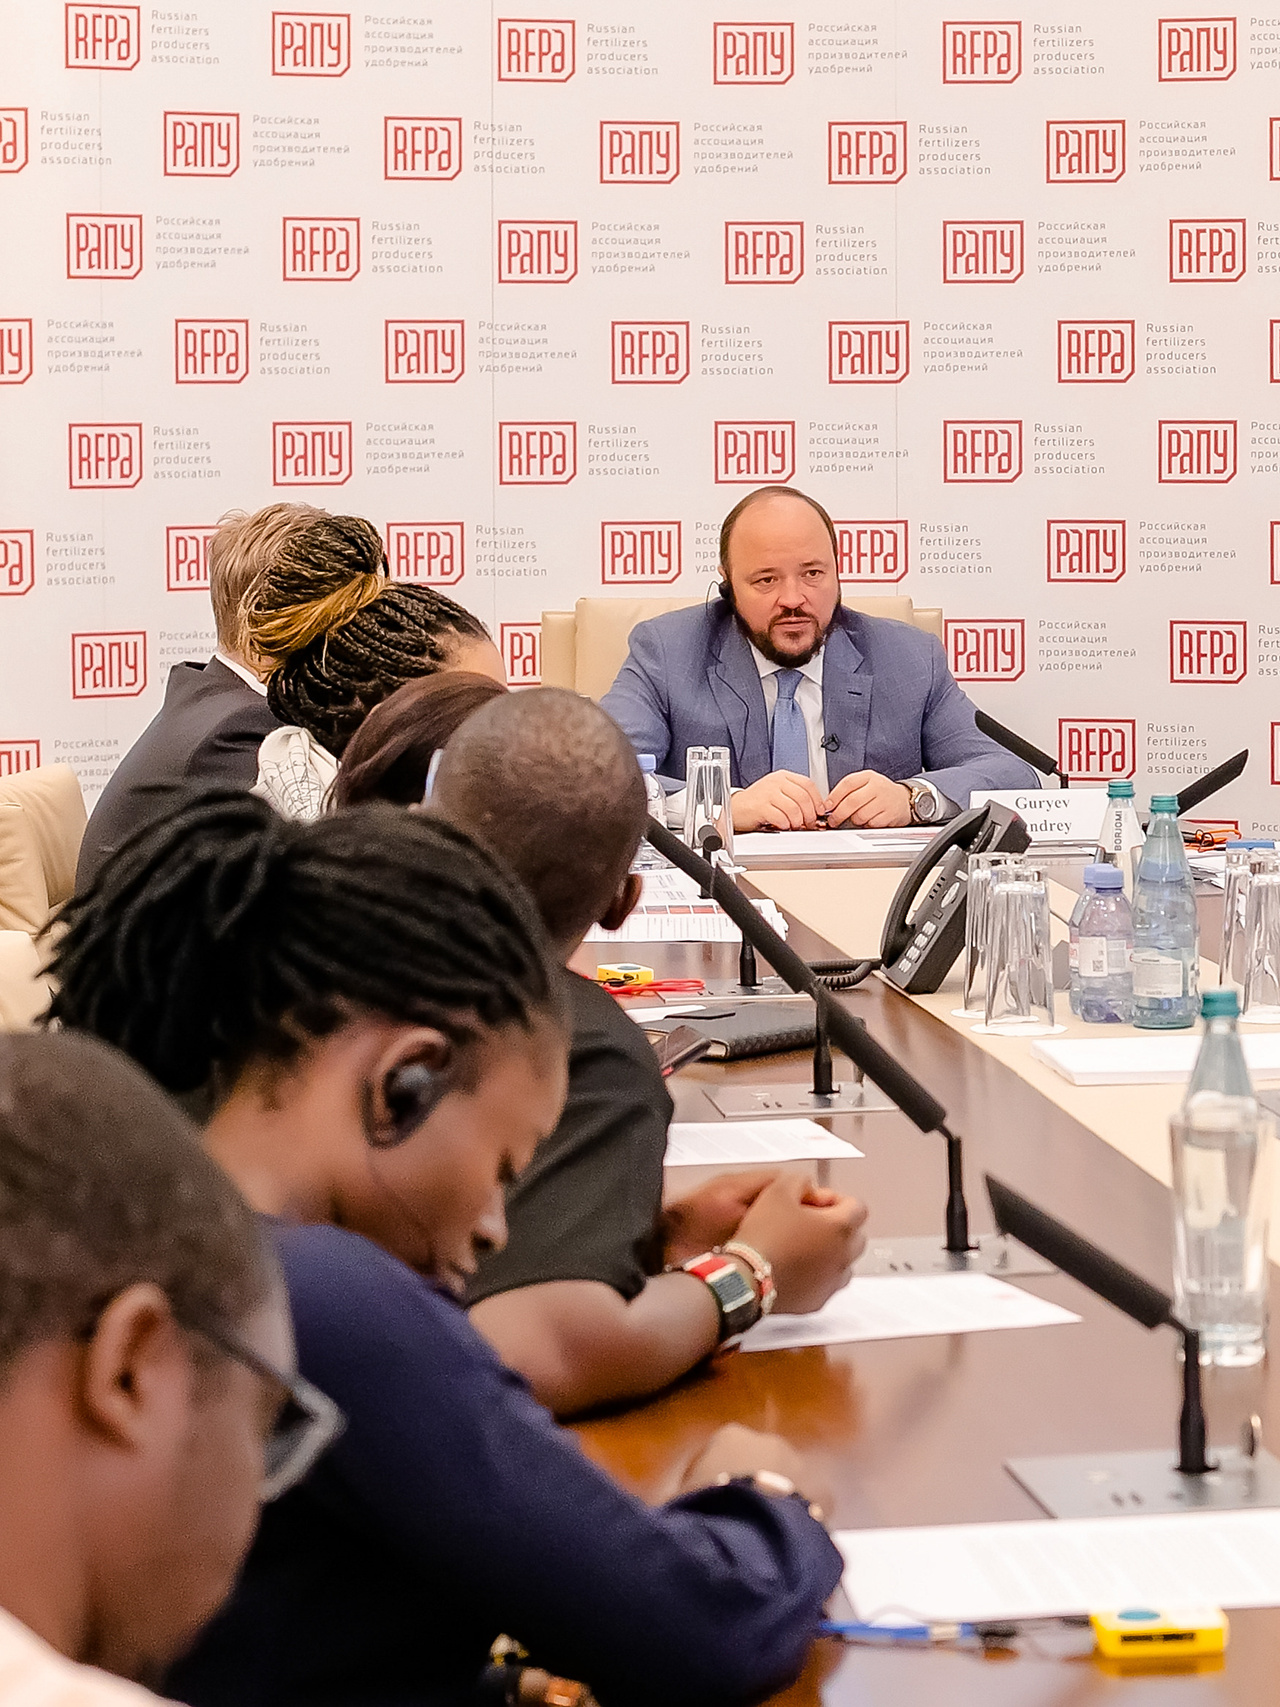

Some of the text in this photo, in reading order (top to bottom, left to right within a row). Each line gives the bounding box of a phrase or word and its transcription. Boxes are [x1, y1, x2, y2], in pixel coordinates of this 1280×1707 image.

[151, 9, 198, 22] Russian
[151, 23, 210, 37] fertilizers
[586, 22, 636, 34] Russian
[807, 22, 878, 34] Российская
[1033, 23, 1083, 35] Russian
[151, 39, 211, 51] producers
[586, 36, 649, 49] fertilizers
[807, 38, 879, 47] ассоциация
[1032, 37, 1095, 48] fertilizers
[150, 54, 220, 66] association
[586, 51, 649, 63] producers
[807, 49, 908, 62] производителей
[1032, 50, 1096, 63] producers
[586, 65, 659, 76] association
[807, 63, 873, 75] удобрений
[1032, 64, 1105, 76] association
[693, 121, 763, 133] Российская
[918, 123, 968, 135] Russian
[1138, 119, 1207, 130] Российская
[693, 137, 764, 147] ассоциация
[918, 137, 981, 148] fertilizers
[1138, 135, 1208, 144] ассоциация
[693, 150, 794, 161] производителей
[918, 151, 982, 164] producers
[1138, 146, 1236, 159] производителей
[693, 163, 759, 175] удобрений
[918, 164, 991, 176] association
[1138, 160, 1202, 173] удобрений
[591, 221, 660, 232] Российская
[815, 223, 865, 235] Russian
[1037, 221, 1106, 231] Российская
[590, 237, 662, 247] ассоциация
[815, 237, 878, 249] fertilizers
[1037, 236, 1108, 246] ассоциация
[591, 249, 691, 261] производителей
[815, 251, 878, 264] producers
[1037, 248, 1136, 260] производителей
[590, 262, 656, 275] удобрений
[815, 265, 888, 276] association
[1037, 262, 1102, 274] удобрений
[701, 323, 751, 335] Russian
[923, 321, 993, 332] Российская
[1146, 322, 1194, 334] Russian
[701, 337, 763, 349] fertilizers
[922, 336, 994, 346] ассоциация
[1145, 336, 1206, 347] fertilizers
[700, 351, 764, 364] producers
[923, 348, 1024, 360] производителей
[1145, 350, 1207, 363] producers
[700, 365, 774, 376] association
[922, 362, 989, 374] удобрений
[1145, 364, 1217, 375] association
[152, 425, 200, 437] Russian
[587, 424, 637, 435] Russian
[808, 421, 878, 432] Российская
[1034, 422, 1083, 434] Russian
[152, 439, 211, 451] fertilizers
[587, 437, 649, 449] fertilizers
[808, 437, 880, 446] ассоциация
[1033, 436, 1095, 448] fertilizers
[152, 454, 212, 467] producers
[587, 451, 650, 464] producers
[808, 448, 909, 461] производителей
[1033, 450, 1096, 463] producers
[153, 468, 222, 480] association
[587, 465, 660, 476] association
[808, 462, 874, 474] удобрений
[1033, 464, 1106, 475] association
[919, 522, 969, 533] Russian
[1139, 520, 1207, 532] Российская
[919, 535, 982, 547] fertilizers
[1138, 536, 1208, 546] ассоциация
[919, 549, 983, 562] producers
[1138, 549, 1237, 560] производителей
[919, 563, 993, 574] association
[1138, 562, 1202, 574] удобрений
[1038, 619, 1107, 630] Российская
[1038, 635, 1108, 645] ассоциация
[1038, 648, 1137, 659] производителей
[1038, 660, 1103, 673] удобрений
[1146, 722, 1195, 734] Russian
[1146, 735, 1208, 748] fertilizers
[1146, 750, 1208, 762] producers
[1014, 795, 1071, 812] Guryev
[1025, 818, 1073, 834] ndrey
[1113, 810, 1124, 851] BORJOMI
